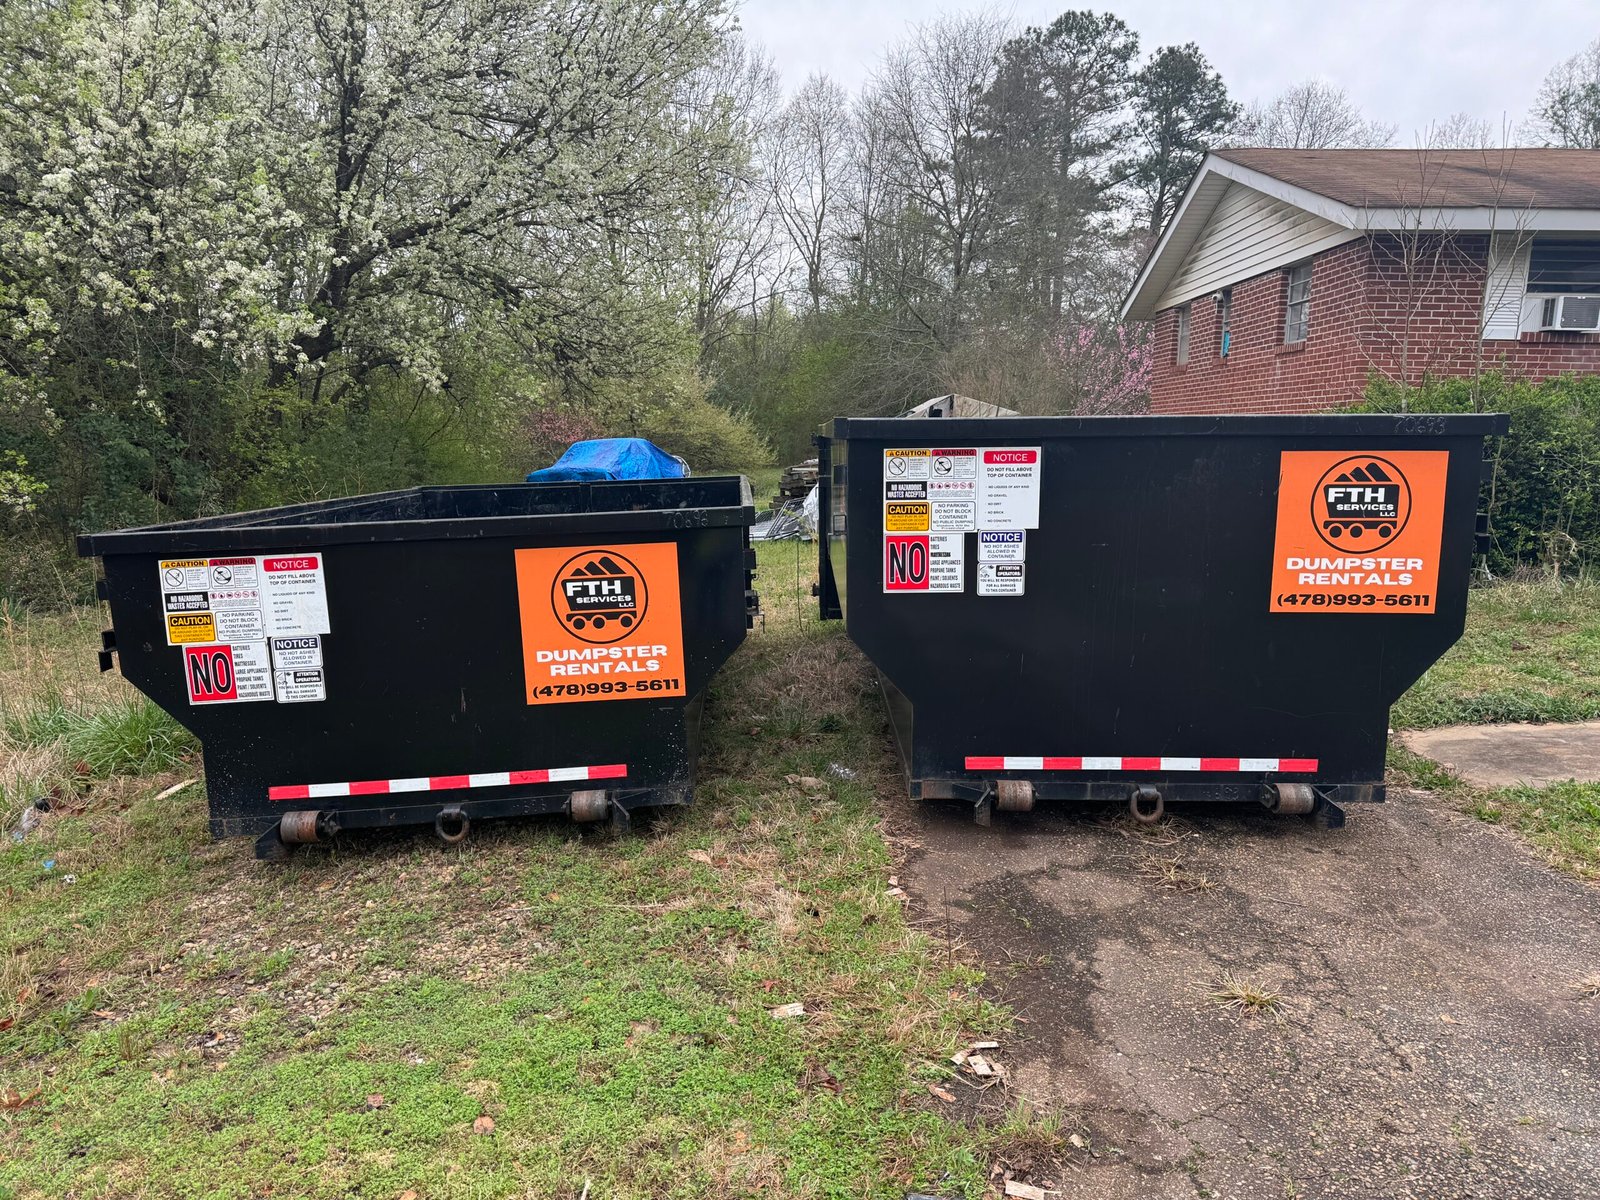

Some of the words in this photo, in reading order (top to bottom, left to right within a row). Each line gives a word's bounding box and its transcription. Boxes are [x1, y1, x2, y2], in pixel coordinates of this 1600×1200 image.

[993, 454, 1028, 462] NOTICE
[1328, 488, 1385, 502] FTH
[889, 506, 926, 514] CAUTION
[983, 533, 1020, 541] NOTICE
[273, 560, 309, 569] NOTICE
[888, 541, 926, 584] NO
[1286, 558, 1423, 571] DUMPSTER
[1298, 573, 1413, 585] RENTALS
[566, 579, 622, 596] FTH
[576, 595, 632, 603] SERVICES
[1277, 594, 1429, 606] (478)993-5611
[168, 602, 184, 610] WASTES
[186, 601, 208, 609] ACCEPTED
[171, 617, 210, 625] CAUTION
[276, 638, 316, 649] NOTICE
[536, 645, 667, 663] DUMPSTER
[189, 652, 232, 695] NO
[550, 659, 659, 677] RENTALS
[533, 679, 679, 699] (478)993-5611
